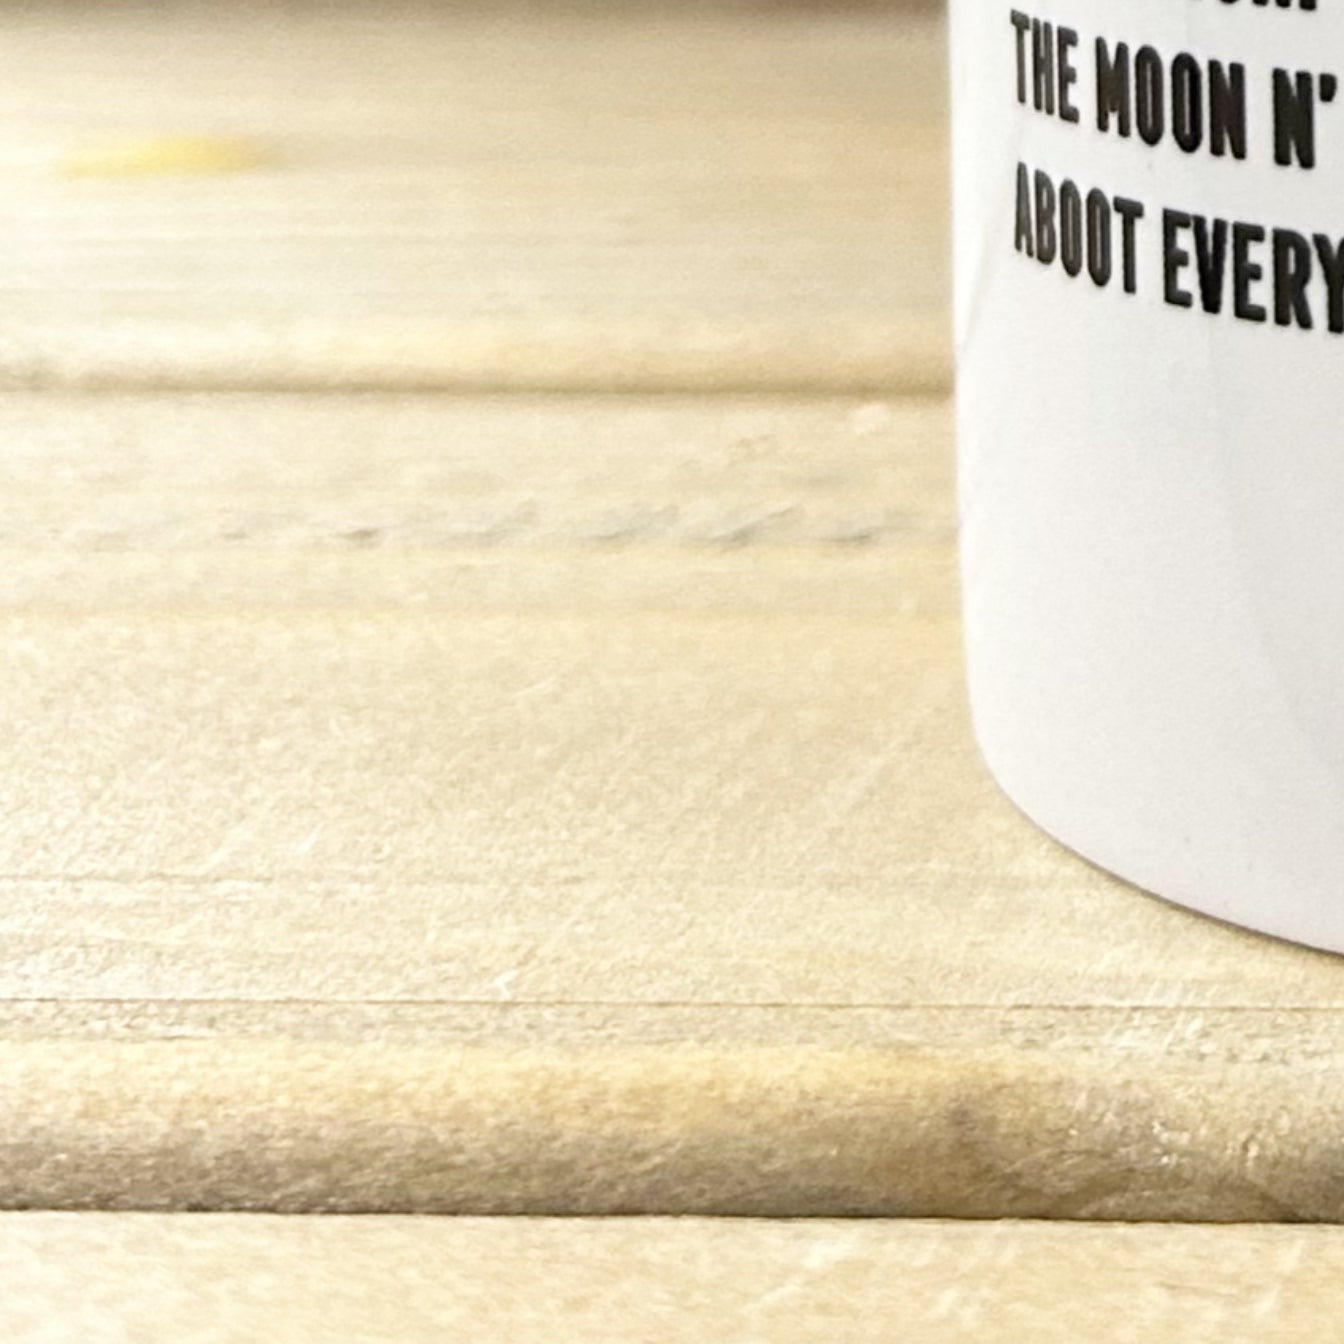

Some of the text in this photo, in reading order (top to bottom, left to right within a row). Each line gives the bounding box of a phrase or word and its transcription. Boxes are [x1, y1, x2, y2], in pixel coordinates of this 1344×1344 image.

[1010, 10, 1079, 124] THE
[1095, 37, 1247, 161] MOON
[1014, 162, 1144, 294] ABOOT
